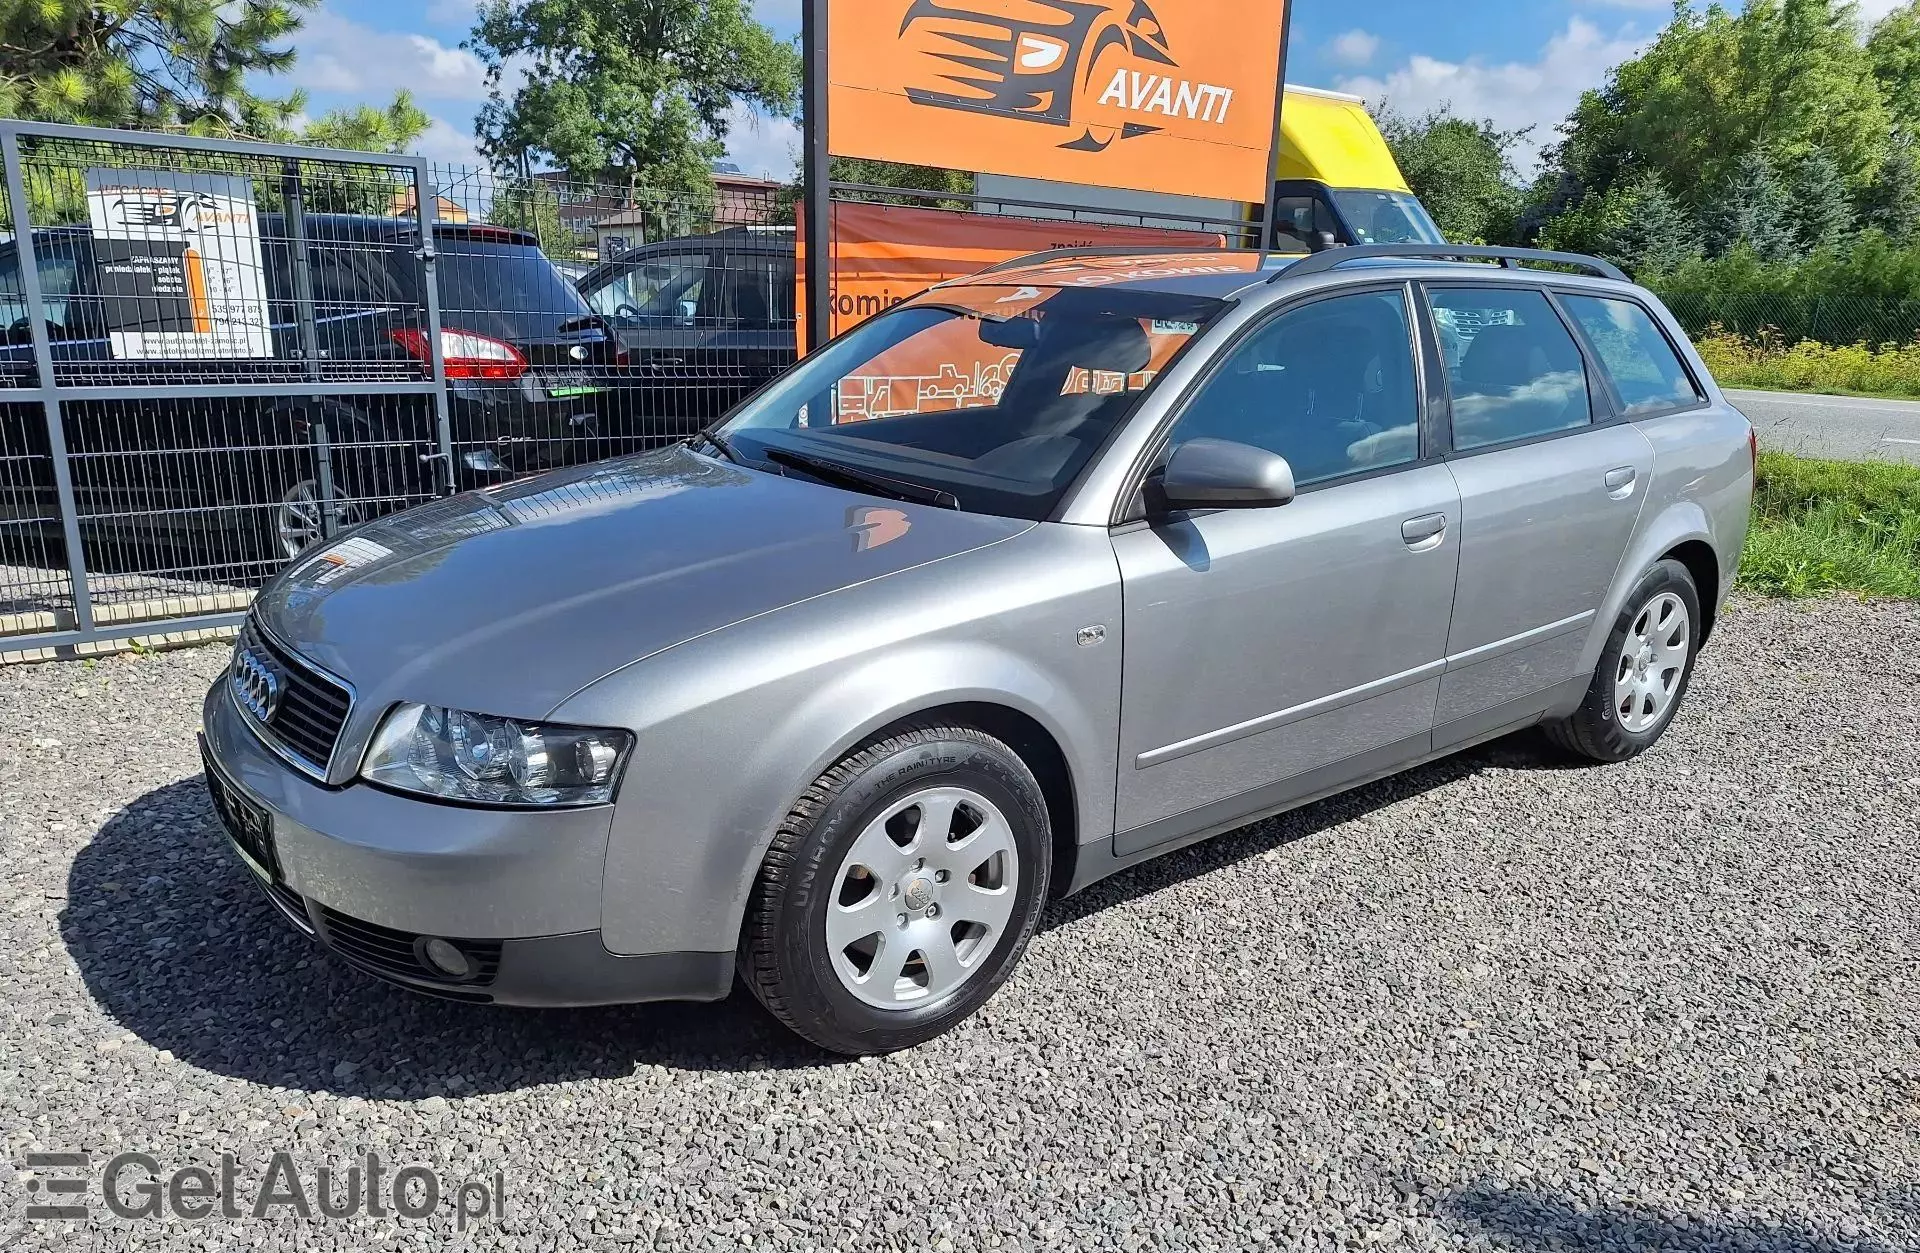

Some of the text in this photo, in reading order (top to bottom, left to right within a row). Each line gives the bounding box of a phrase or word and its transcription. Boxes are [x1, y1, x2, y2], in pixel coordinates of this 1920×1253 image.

[1097, 68, 1234, 125] AVANTI
[192, 211, 251, 224] AVANTI
[792, 756, 956, 907] UNIROYAL THE RAIN TYRE
